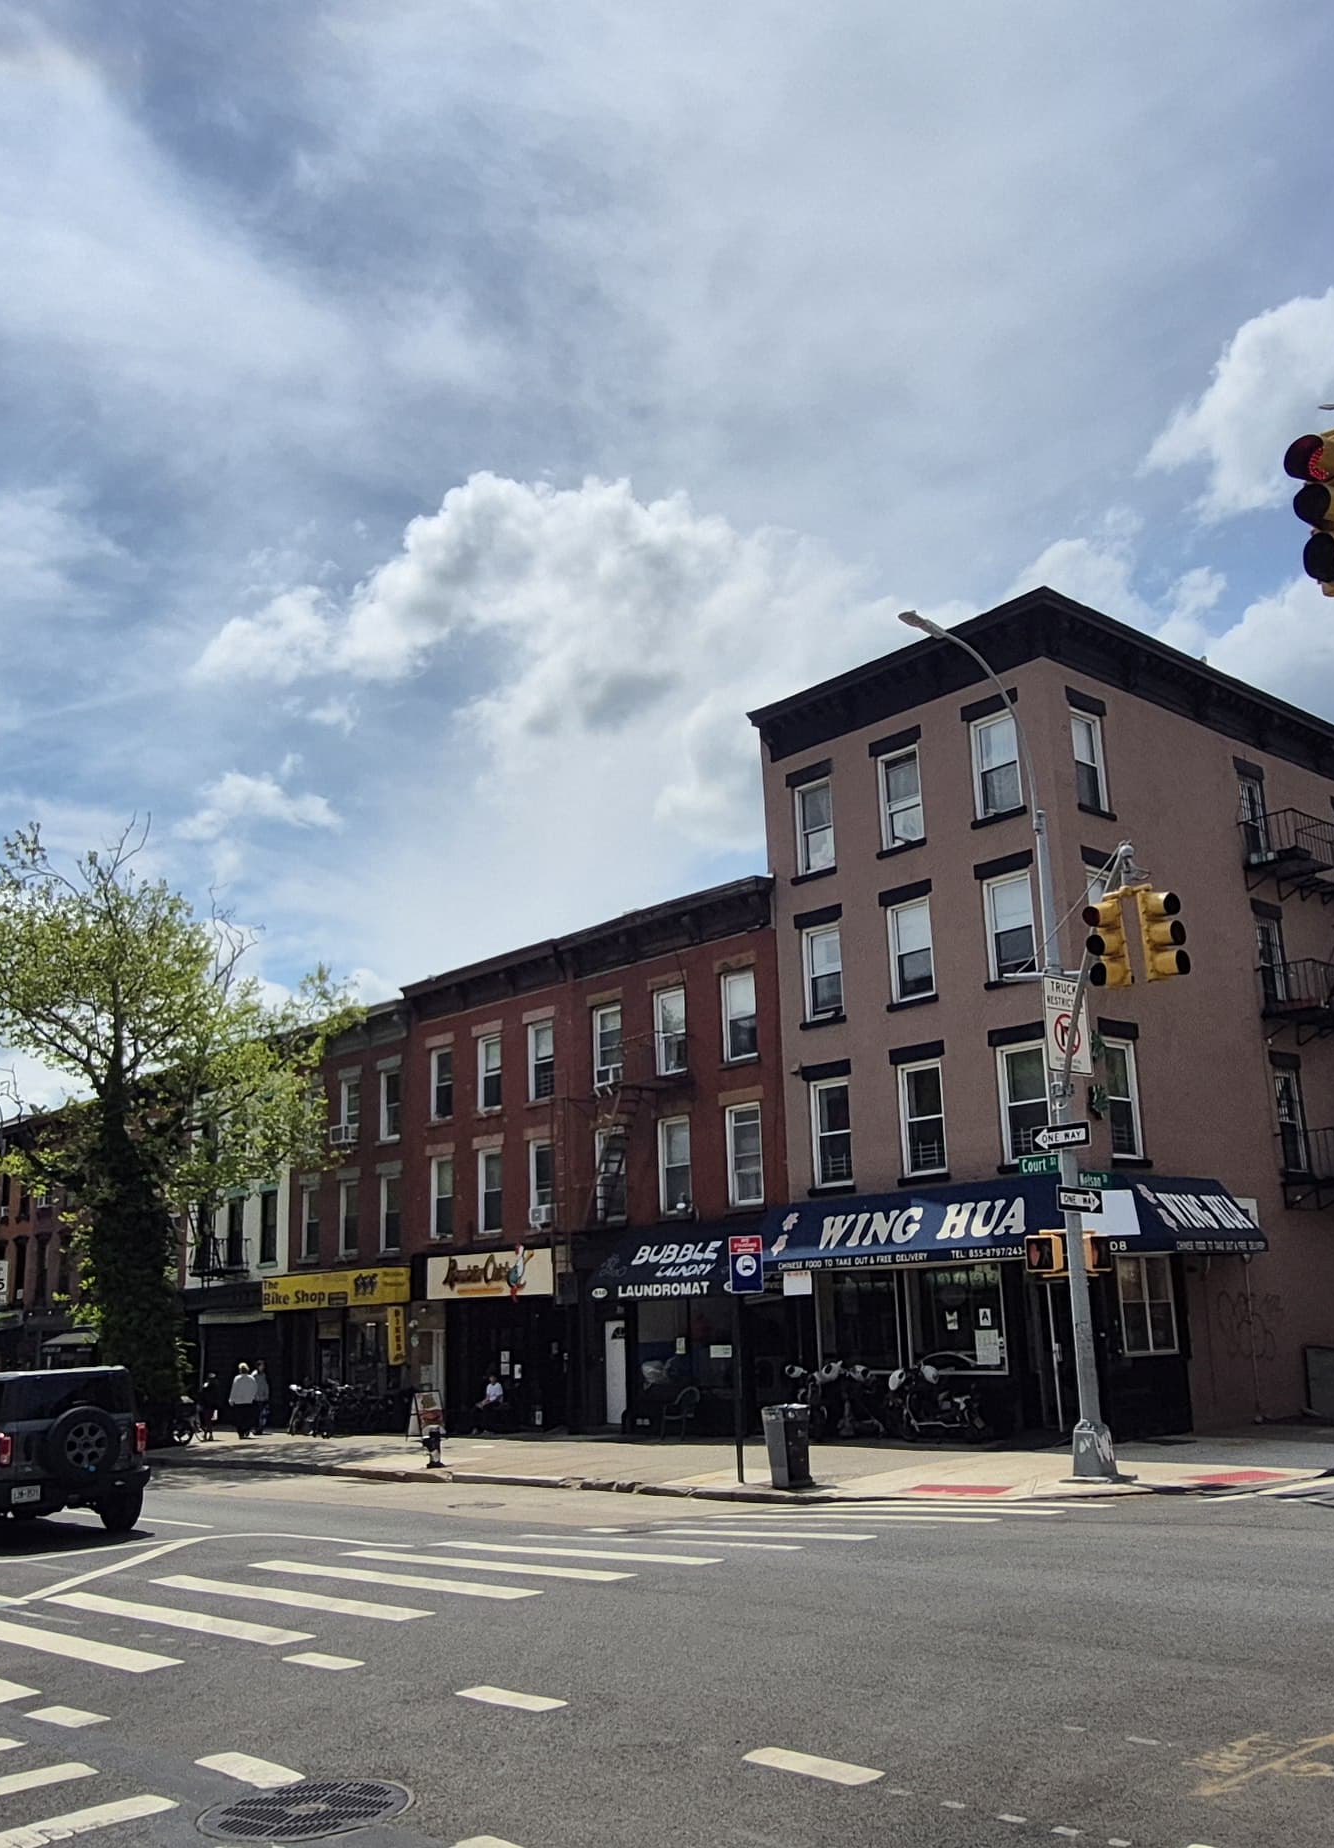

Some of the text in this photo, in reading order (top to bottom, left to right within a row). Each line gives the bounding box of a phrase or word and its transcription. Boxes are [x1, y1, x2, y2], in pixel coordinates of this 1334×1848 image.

[1042, 1130, 1081, 1143] ONE WAY
[1022, 1158, 1046, 1173] Court
[1079, 1173, 1102, 1187] Nelson
[1064, 1194, 1096, 1204] ONE WAY
[1155, 1193, 1219, 1229] WING
[1199, 1195, 1255, 1229] HUA
[819, 1207, 924, 1250] WING
[936, 1197, 1026, 1240] HUA
[631, 1241, 723, 1265] BUBBLE
[778, 1260, 803, 1270] CHINESE
[805, 1259, 822, 1268] FOOD
[825, 1259, 833, 1267] TO
[836, 1257, 852, 1266] TAKE
[855, 1256, 868, 1265] OUT
[876, 1254, 892, 1264] FREE
[895, 1252, 928, 1262] DELIVERY
[655, 1262, 716, 1277] LAUNDRY
[264, 1281, 279, 1290] The
[618, 1281, 710, 1298] LAUNDROMAT
[264, 1292, 290, 1305] Bike
[294, 1289, 326, 1306] Shop
[982, 1310, 989, 1320] A
